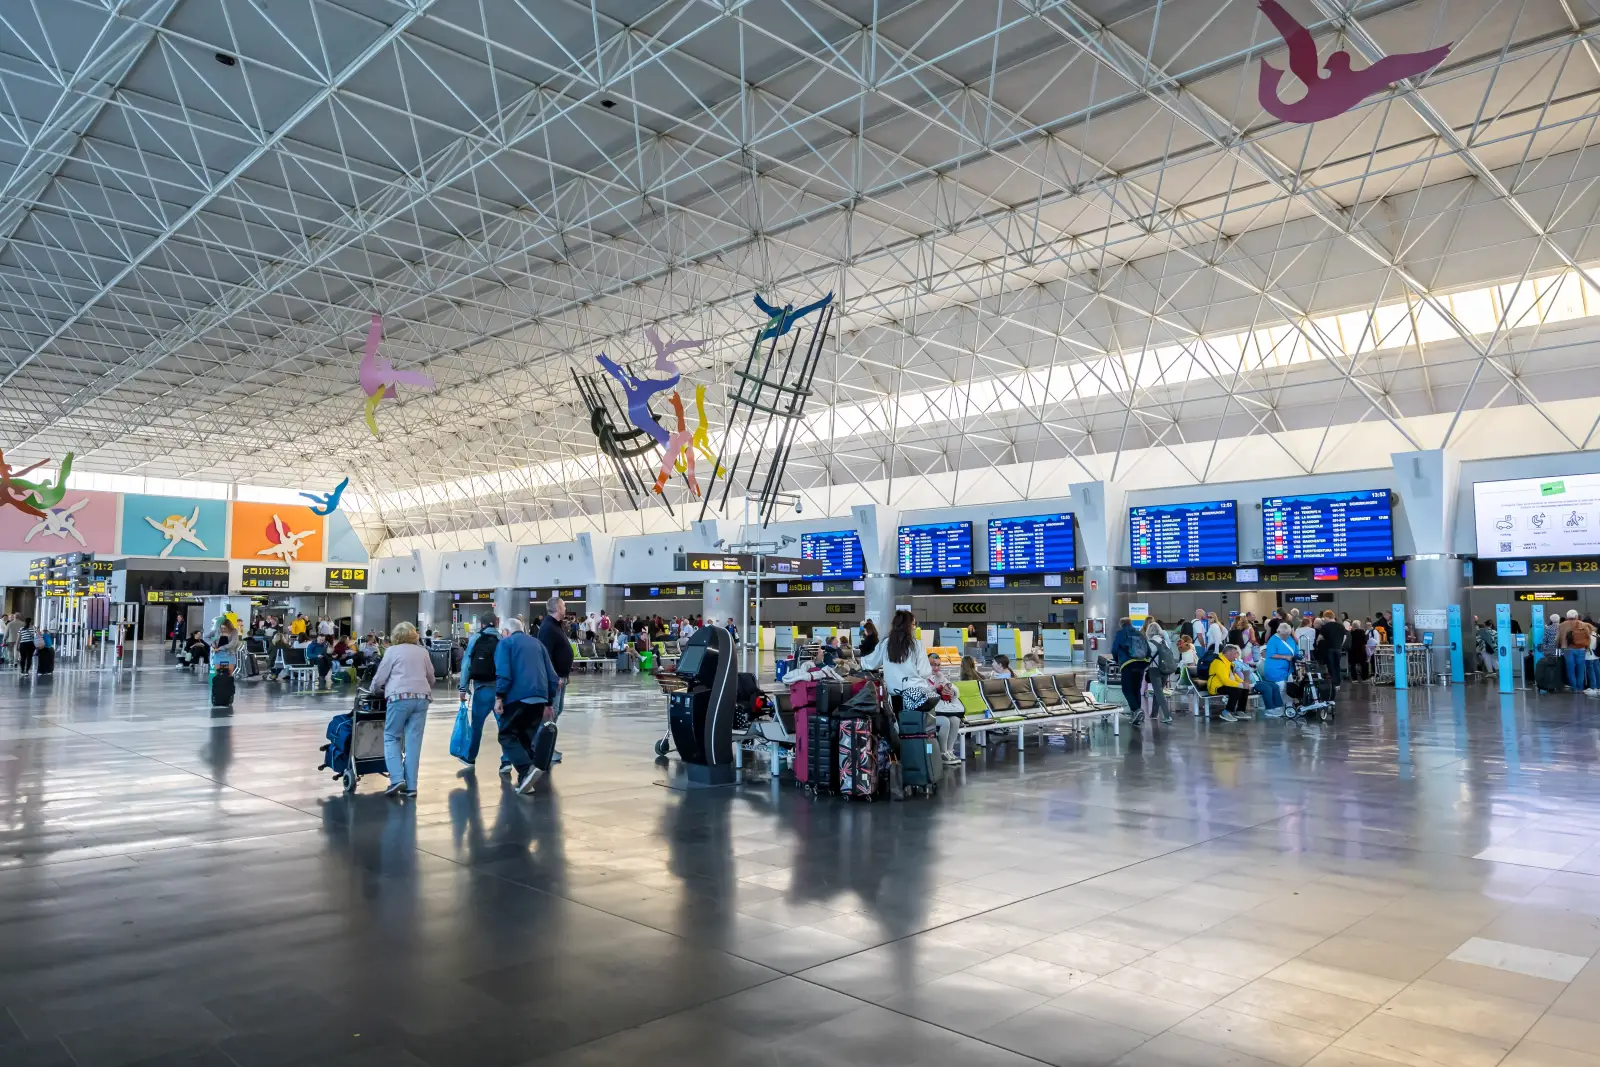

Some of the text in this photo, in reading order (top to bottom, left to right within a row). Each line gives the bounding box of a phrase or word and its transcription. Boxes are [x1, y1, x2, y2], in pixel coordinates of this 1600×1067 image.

[1533, 563, 1555, 573] 327
[1575, 561, 1598, 572] 328
[258, 568, 289, 576] 101:234
[1190, 571, 1232, 581] 323 324
[1343, 568, 1361, 578] 325
[1377, 567, 1397, 577] 326
